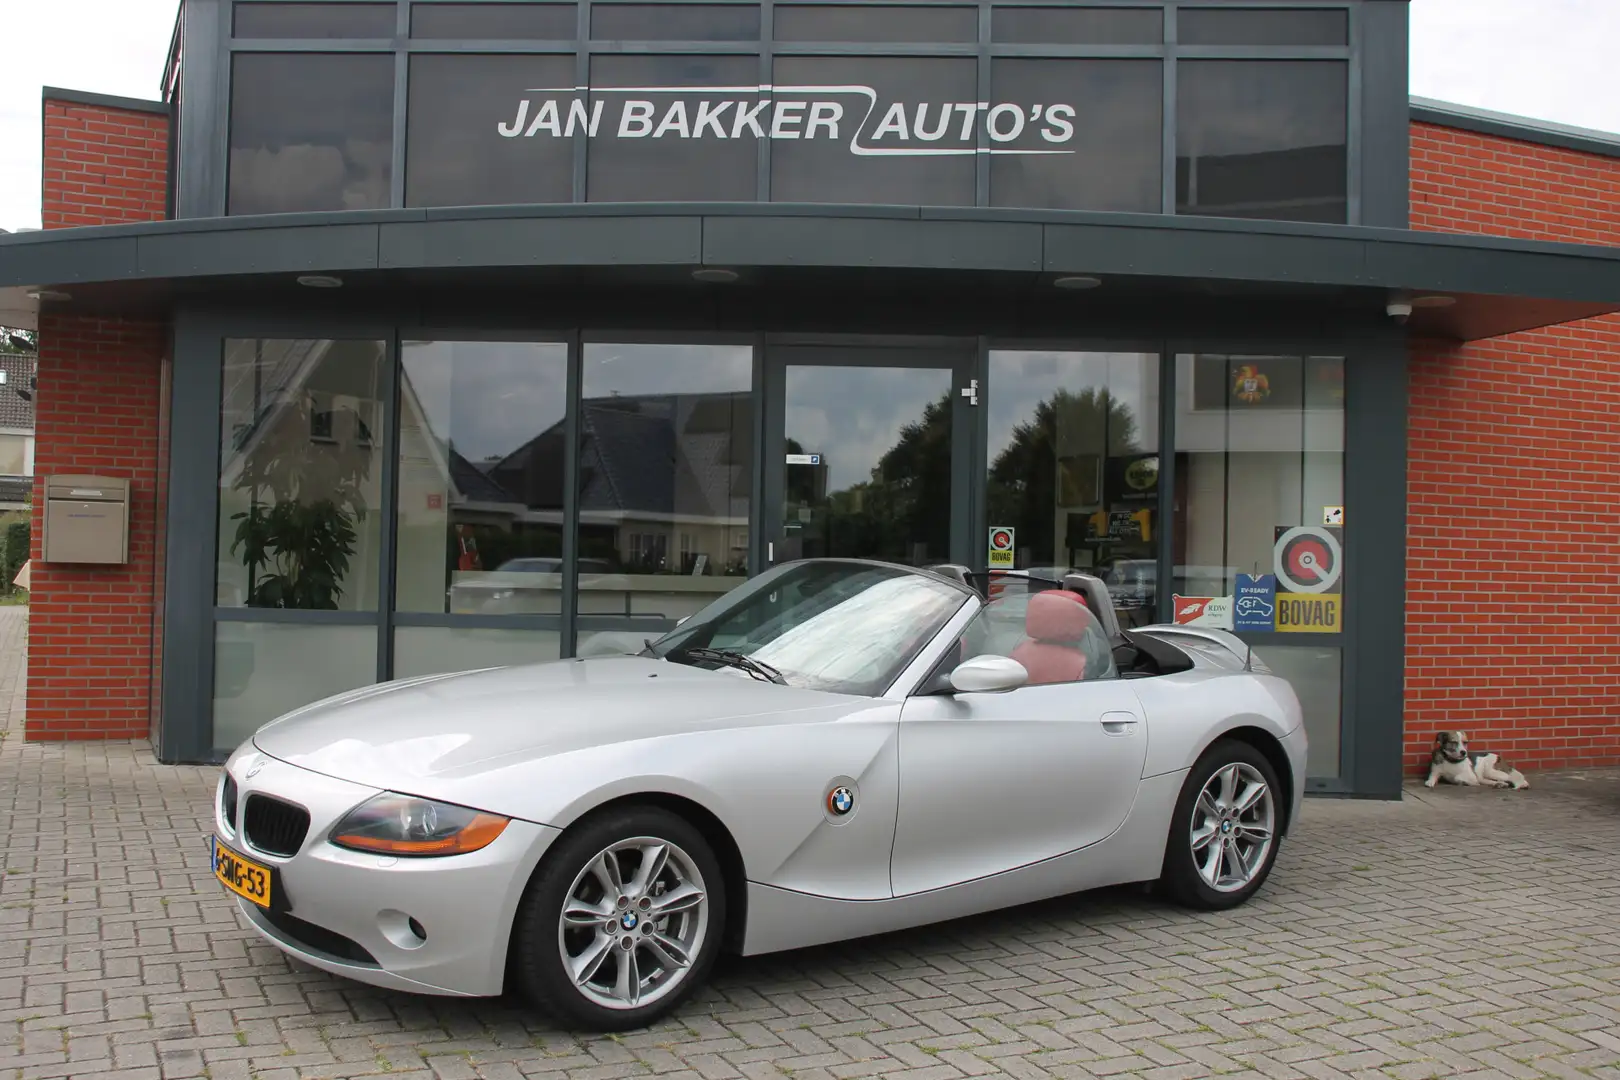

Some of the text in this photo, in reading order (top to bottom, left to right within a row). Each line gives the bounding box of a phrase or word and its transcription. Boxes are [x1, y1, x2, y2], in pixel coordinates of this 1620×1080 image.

[498, 99, 1076, 143] JAN BAKKER AUTO'S
[991, 552, 1011, 562] BOVAG
[1208, 604, 1227, 612] RDW
[1279, 599, 1335, 626] BOVAG
